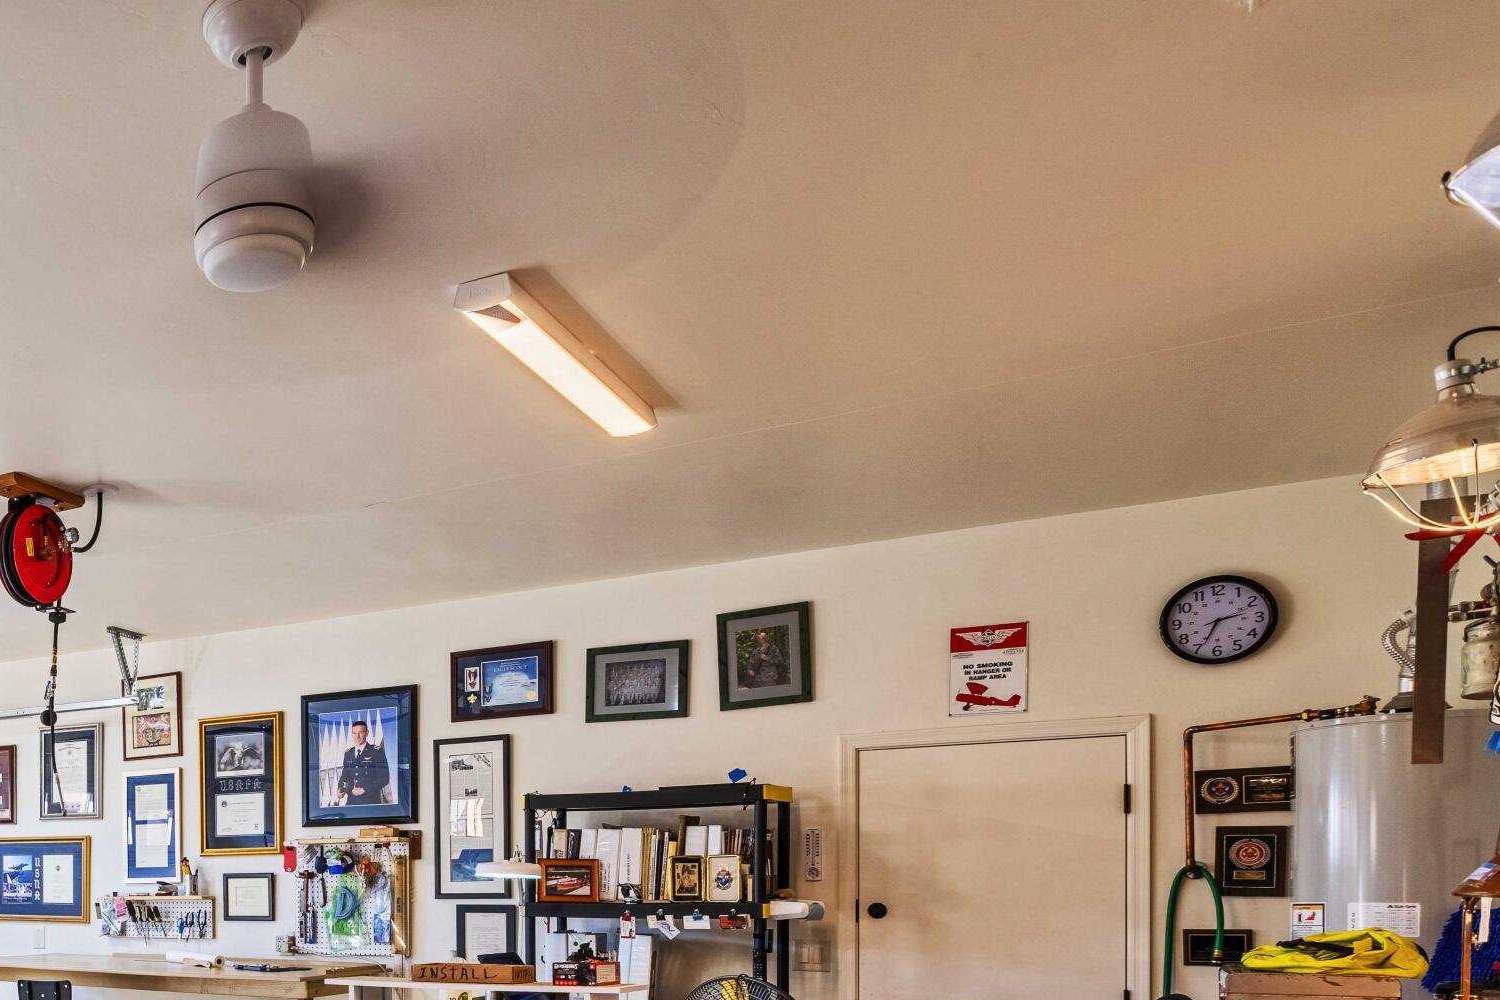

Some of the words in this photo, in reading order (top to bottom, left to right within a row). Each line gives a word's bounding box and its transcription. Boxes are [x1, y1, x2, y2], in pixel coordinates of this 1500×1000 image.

[1193, 590, 1205, 602] 11
[1210, 585, 1226, 596] 12
[1235, 587, 1241, 598] 1
[1247, 595, 1258, 607] 2
[1177, 602, 1192, 614] 10
[1254, 611, 1265, 623] 3
[1172, 619, 1182, 631] 9
[1179, 633, 1190, 645] 8
[1247, 628, 1258, 638] 4
[1192, 643, 1203, 655] 7
[1212, 645, 1223, 657] 6
[1232, 639, 1242, 651] 5
[977, 661, 1013, 669] SMOKING
[419, 965, 498, 981] INSTALL
